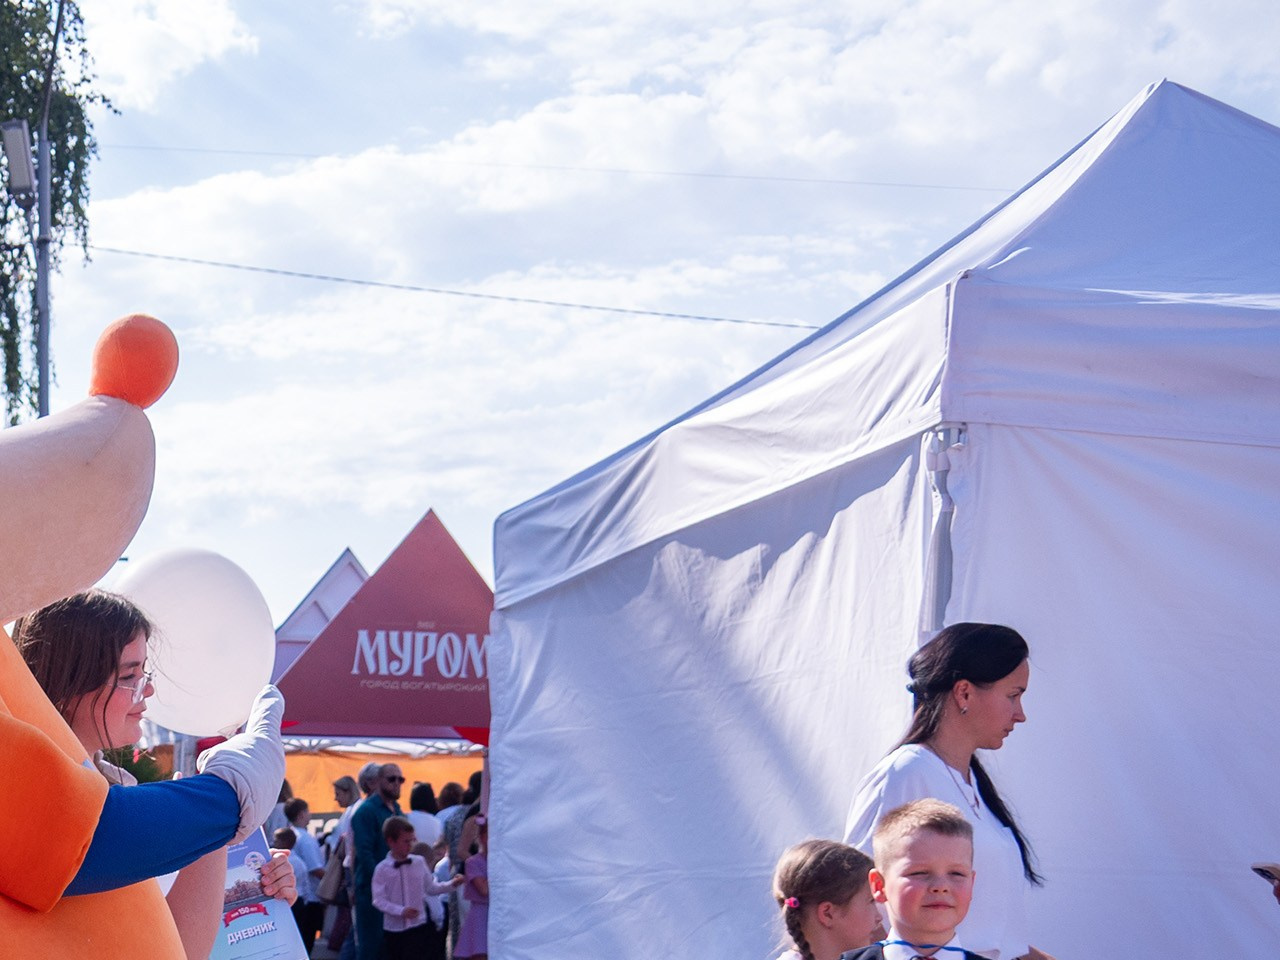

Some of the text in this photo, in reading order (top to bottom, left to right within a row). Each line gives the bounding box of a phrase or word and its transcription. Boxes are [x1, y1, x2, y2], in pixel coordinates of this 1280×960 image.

[351, 629, 489, 679] МУРОМ
[360, 679, 399, 691] ГОРОД
[238, 906, 250, 915] 150
[227, 921, 276, 945] ДНЕВНИК
